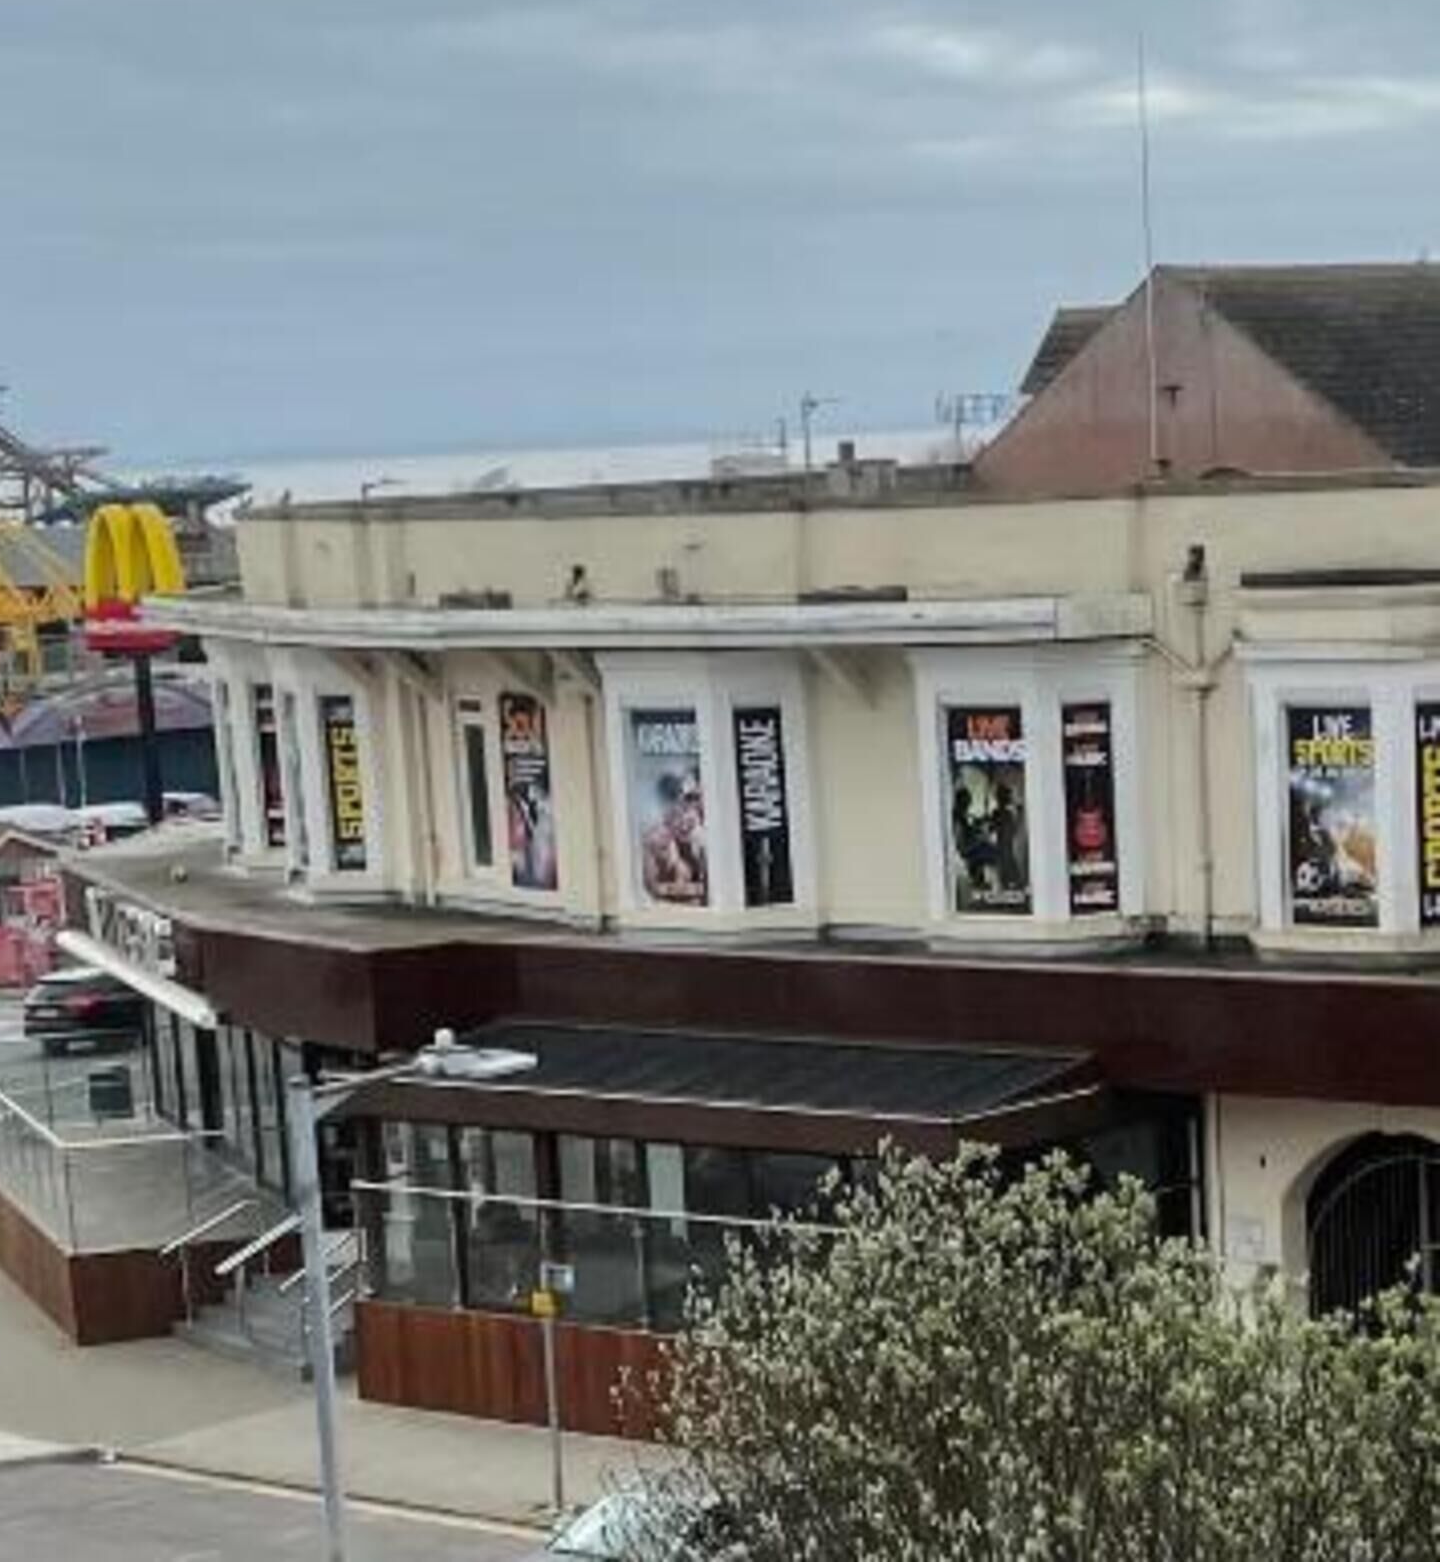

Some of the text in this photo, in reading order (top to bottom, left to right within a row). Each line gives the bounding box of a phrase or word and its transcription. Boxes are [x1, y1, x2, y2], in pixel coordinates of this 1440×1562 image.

[953, 739, 1031, 763] BANDS
[1313, 714, 1354, 741] LIVE
[331, 724, 364, 841] SPORTS
[739, 719, 782, 832] KARAOKE
